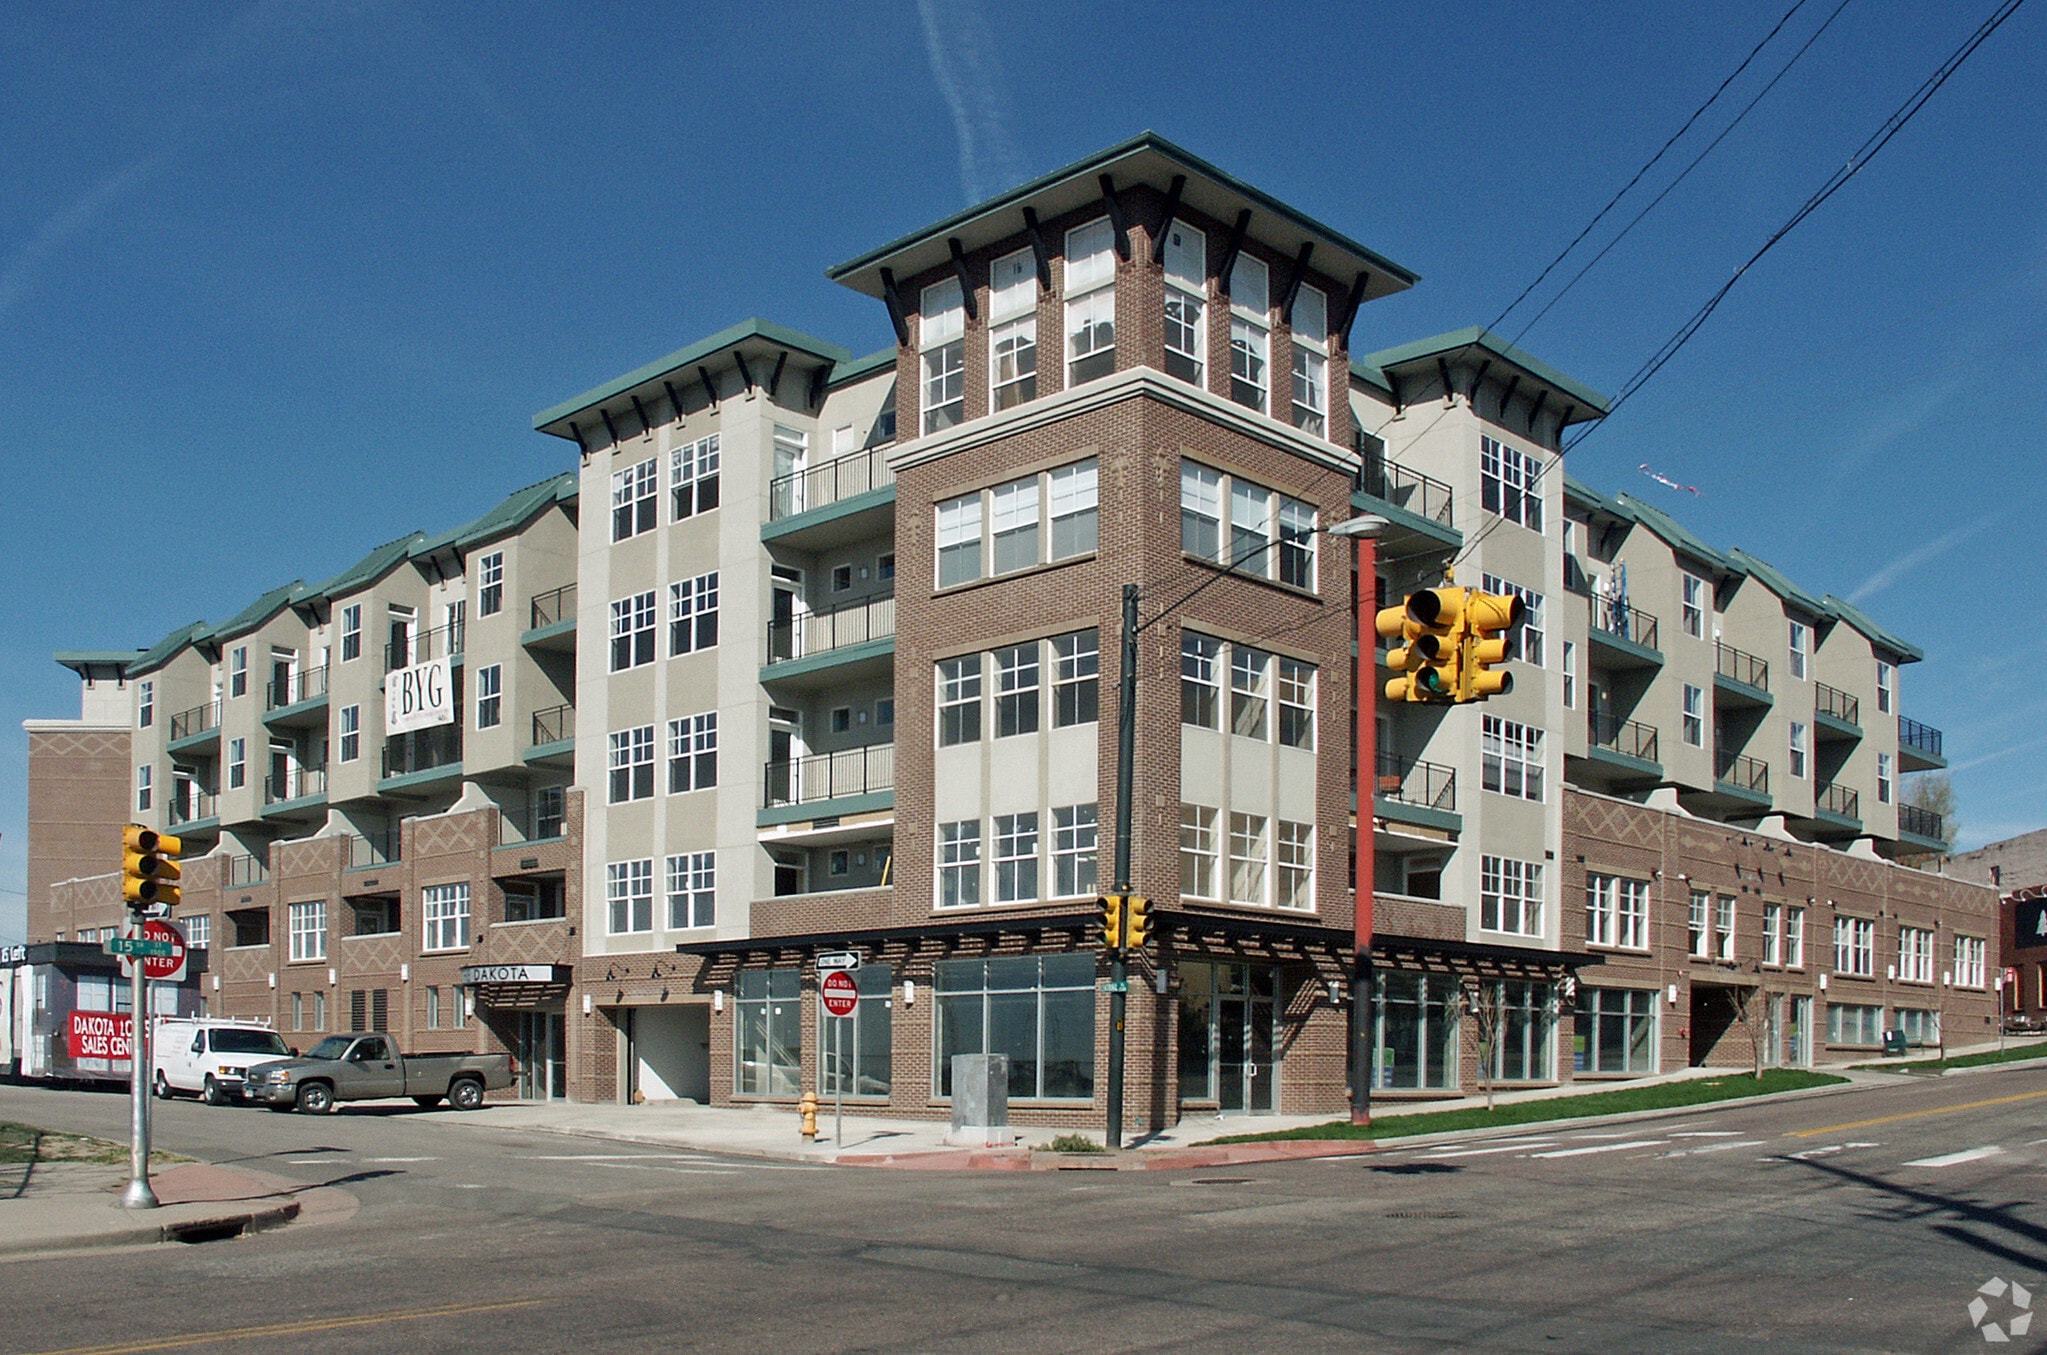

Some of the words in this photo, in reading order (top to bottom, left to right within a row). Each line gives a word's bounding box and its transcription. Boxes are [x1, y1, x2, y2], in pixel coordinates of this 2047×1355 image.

[402, 664, 443, 715] BYG
[118, 941, 133, 952] 15
[144, 957, 174, 968] NTER
[474, 967, 529, 981] DAKOTA
[827, 979, 837, 988] DO
[838, 979, 852, 988] NOT
[828, 999, 852, 1008] ENTER
[74, 1016, 114, 1036] DAKOTA
[81, 1036, 108, 1055] SALES
